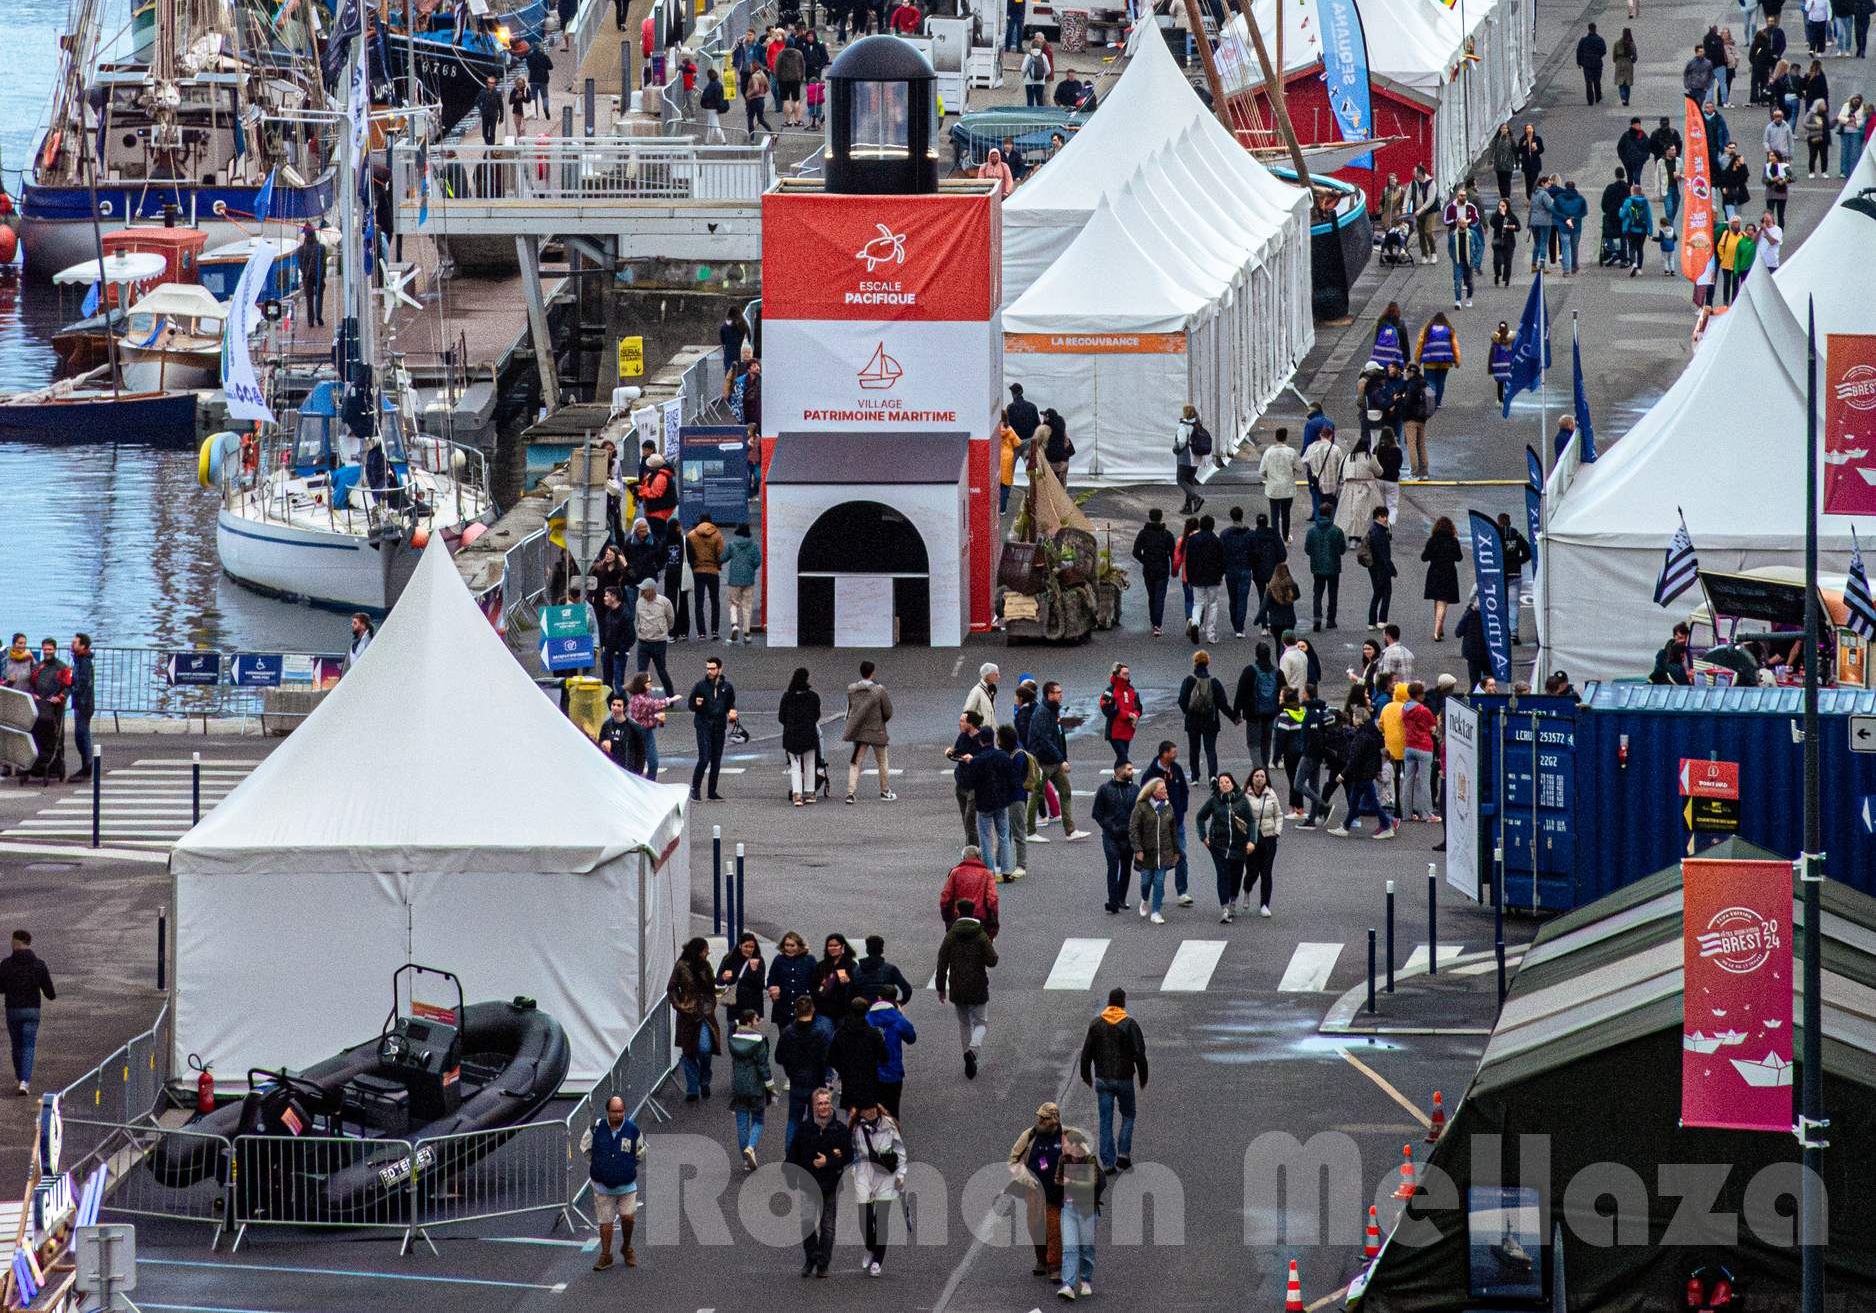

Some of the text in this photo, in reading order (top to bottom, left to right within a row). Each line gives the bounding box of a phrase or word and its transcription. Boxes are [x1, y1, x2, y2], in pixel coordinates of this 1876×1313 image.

[859, 281, 902, 292] ESCALE
[844, 292, 916, 305] PACIFIQUE
[1051, 337, 1139, 347] LA RECOUVRANCE
[857, 398, 903, 410] VILLAGE
[803, 410, 957, 423] PATRIMOINE MARITIME
[1449, 710, 1474, 742] nektar
[1539, 731, 1565, 744] 253572
[1761, 919, 1778, 935] 20
[1721, 932, 1761, 954] BREST
[1763, 933, 1780, 949] 24
